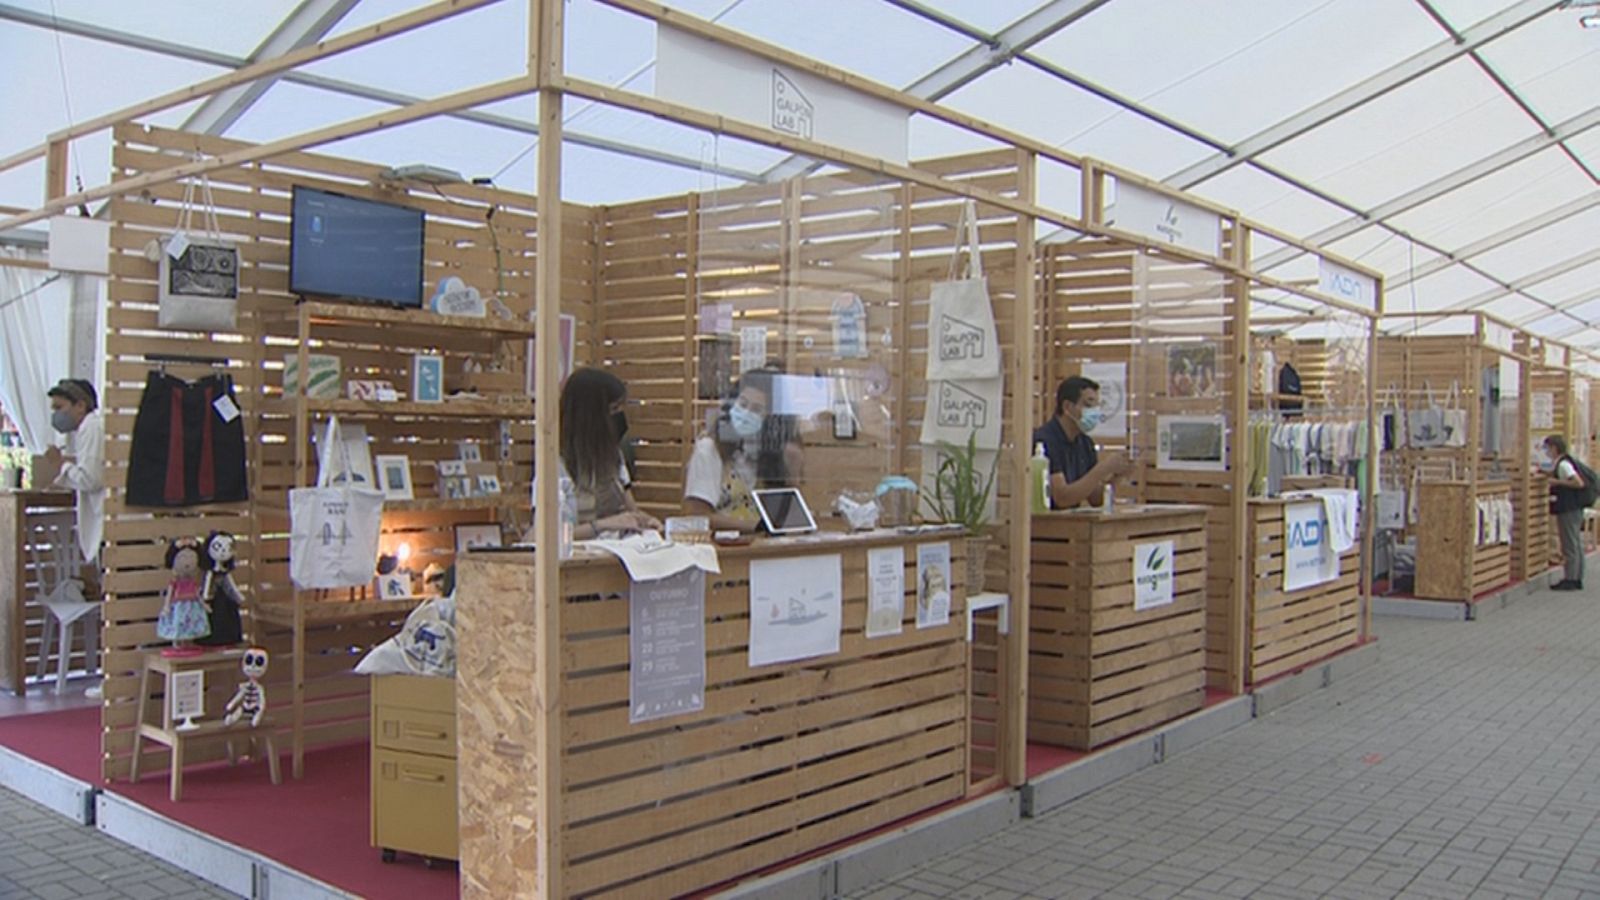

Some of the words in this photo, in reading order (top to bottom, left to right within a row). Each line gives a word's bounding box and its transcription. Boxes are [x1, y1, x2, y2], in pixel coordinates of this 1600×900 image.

[777, 114, 795, 128] LAB
[942, 346, 960, 356] LAB
[941, 413, 960, 423] LAB
